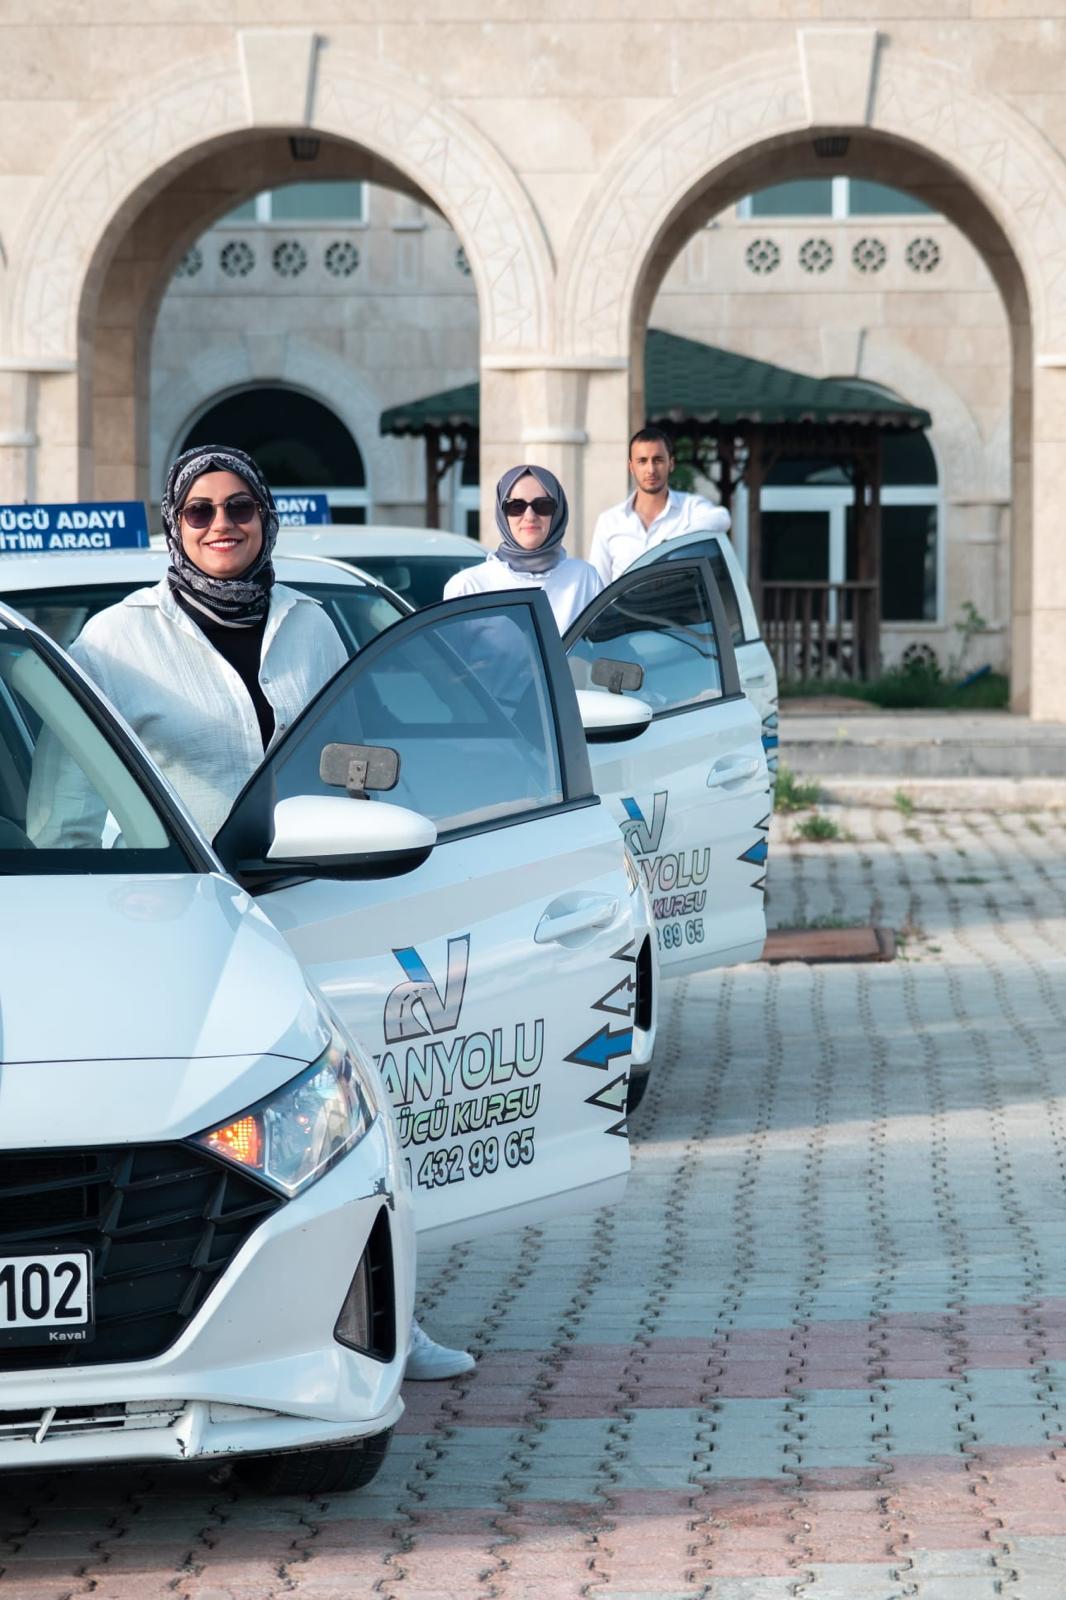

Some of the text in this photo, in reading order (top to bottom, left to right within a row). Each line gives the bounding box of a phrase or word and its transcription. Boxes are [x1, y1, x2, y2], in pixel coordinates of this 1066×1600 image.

[0, 508, 126, 531] ÜCÜ ADAYI
[276, 498, 316, 512] DAYI
[49, 532, 112, 549] ARACI
[637, 847, 711, 894] YOLU
[653, 890, 707, 920] KURSU
[663, 923, 683, 950] 99
[685, 918, 705, 944] 65
[373, 1018, 545, 1108] ANYOLU
[451, 1083, 541, 1136] KURSU
[418, 1145, 464, 1189] 432
[469, 1136, 499, 1178] 99
[504, 1127, 536, 1168] 65
[0, 1261, 83, 1321] 102
